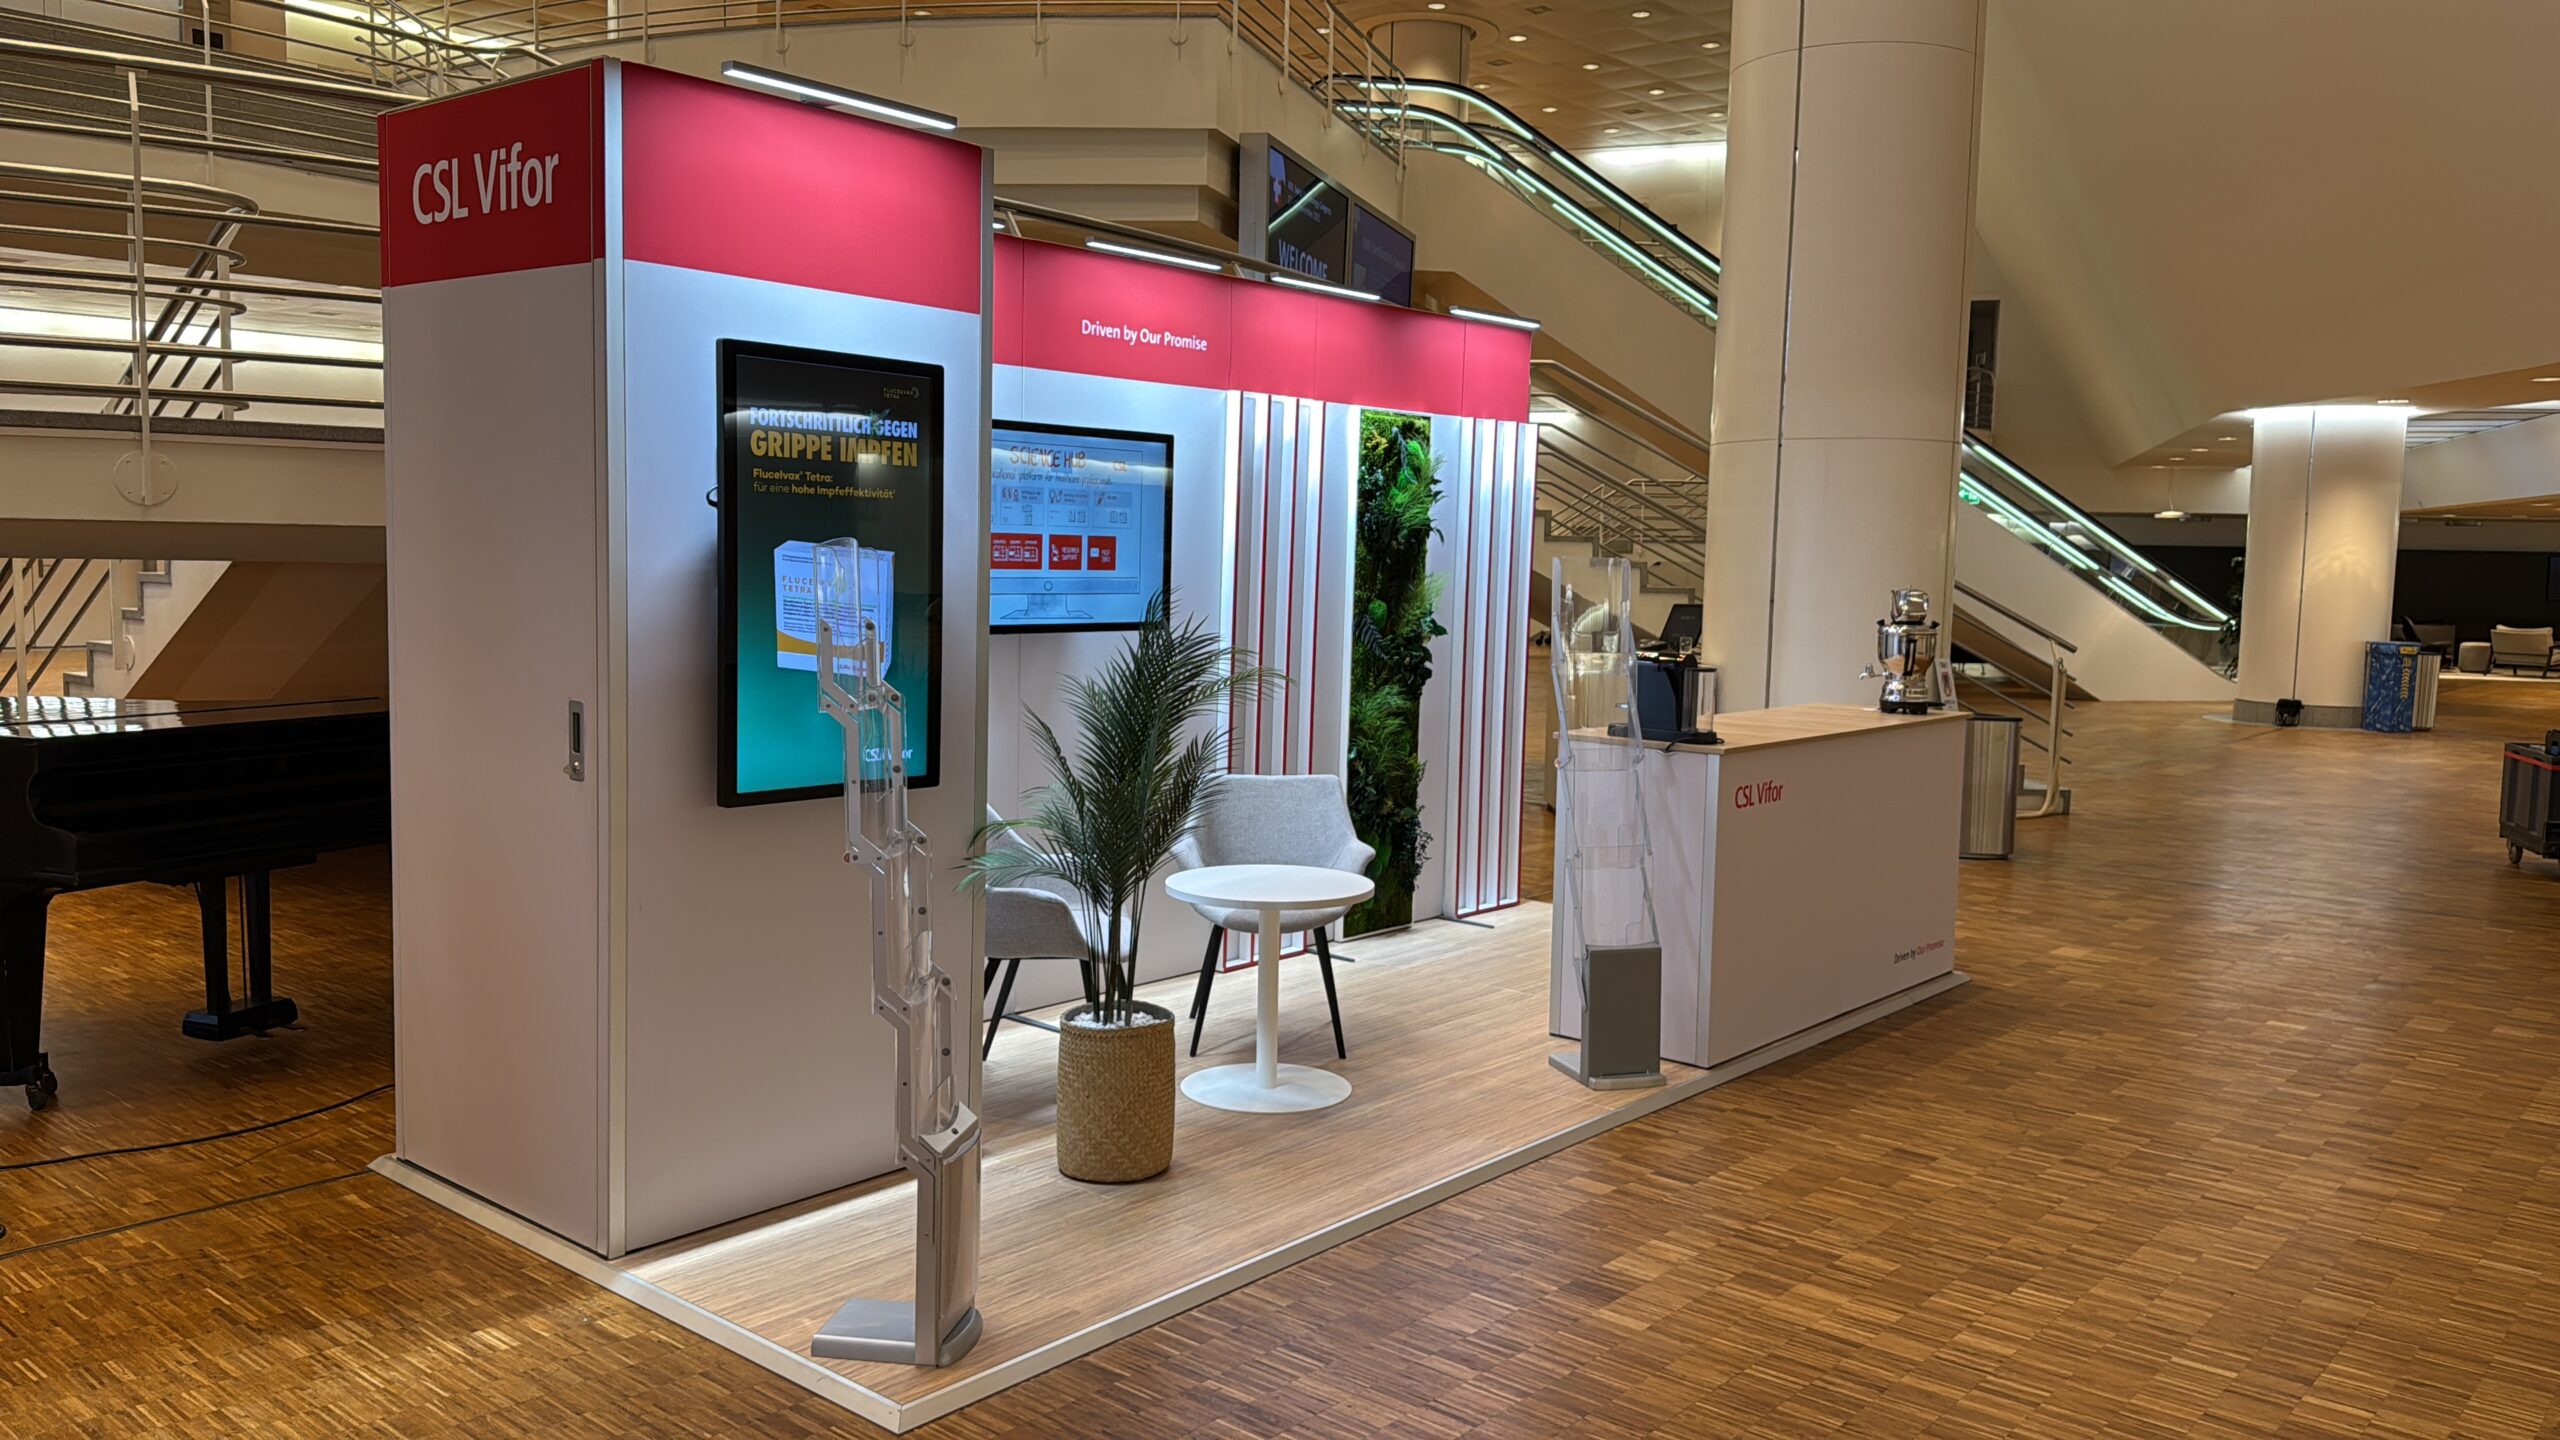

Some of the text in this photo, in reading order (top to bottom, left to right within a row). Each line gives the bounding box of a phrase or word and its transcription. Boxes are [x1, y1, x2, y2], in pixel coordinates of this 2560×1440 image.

[412, 141, 560, 225] CSL Vifor
[1278, 239, 1328, 279] WELCOME
[1081, 319, 1208, 352] Driven by Our Promise
[750, 407, 918, 439] FORTSCHRITTLICH GEGEN
[750, 429, 918, 468] GRIPPE IMPFEN
[1009, 445, 1087, 469] SCIENCE HUB
[753, 481, 768, 492] für
[769, 483, 790, 494] eine
[791, 483, 816, 496] hohe
[805, 471, 833, 483] Tetra:
[783, 585, 813, 595] TETRA
[1735, 780, 1784, 809] CSL Vifor
